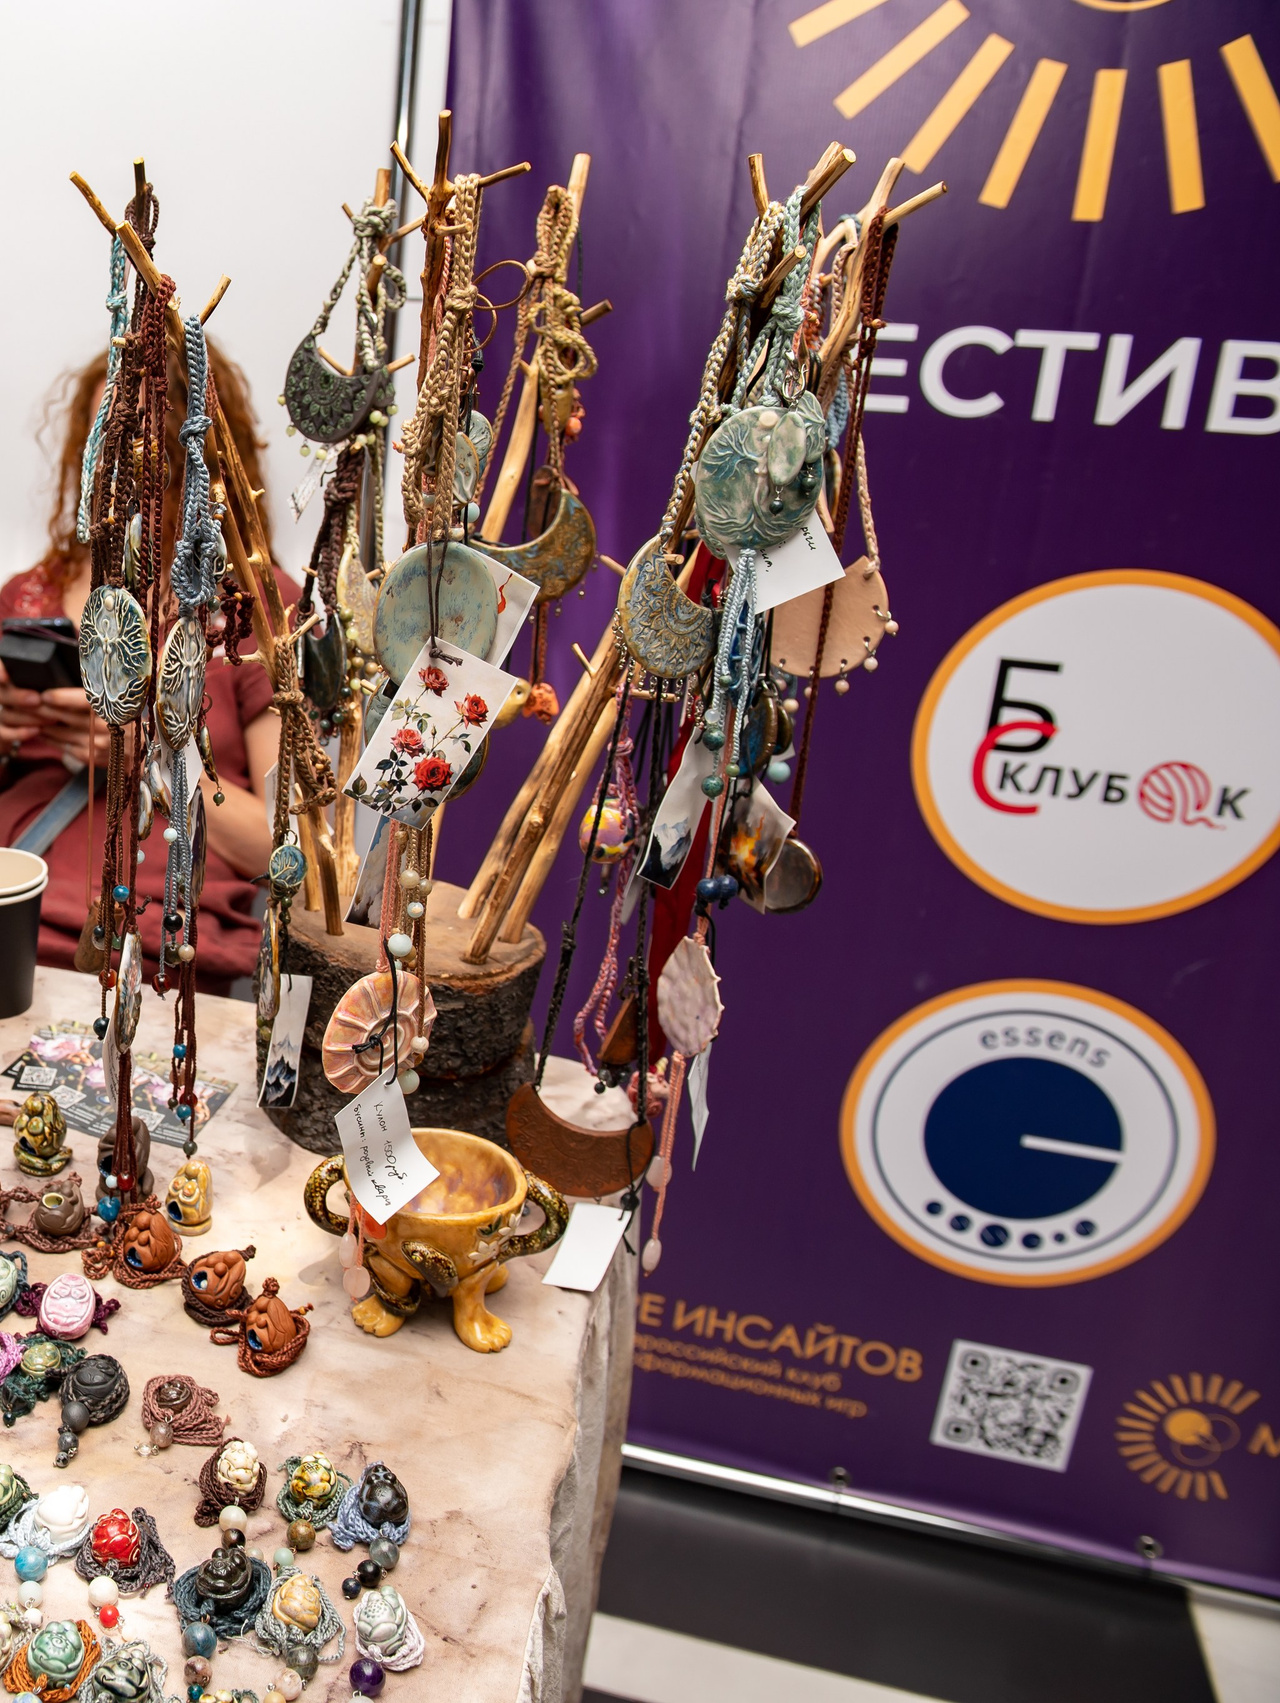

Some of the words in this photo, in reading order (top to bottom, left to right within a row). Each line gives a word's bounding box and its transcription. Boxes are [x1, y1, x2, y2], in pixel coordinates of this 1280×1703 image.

[980, 1027, 1111, 1068] essens
[373, 1100, 388, 1133] Кулон
[636, 1292, 666, 1328] Е
[673, 1299, 923, 1383] ИНСАЙТОВ
[785, 1366, 842, 1393] клуб
[825, 1395, 868, 1420] игр
